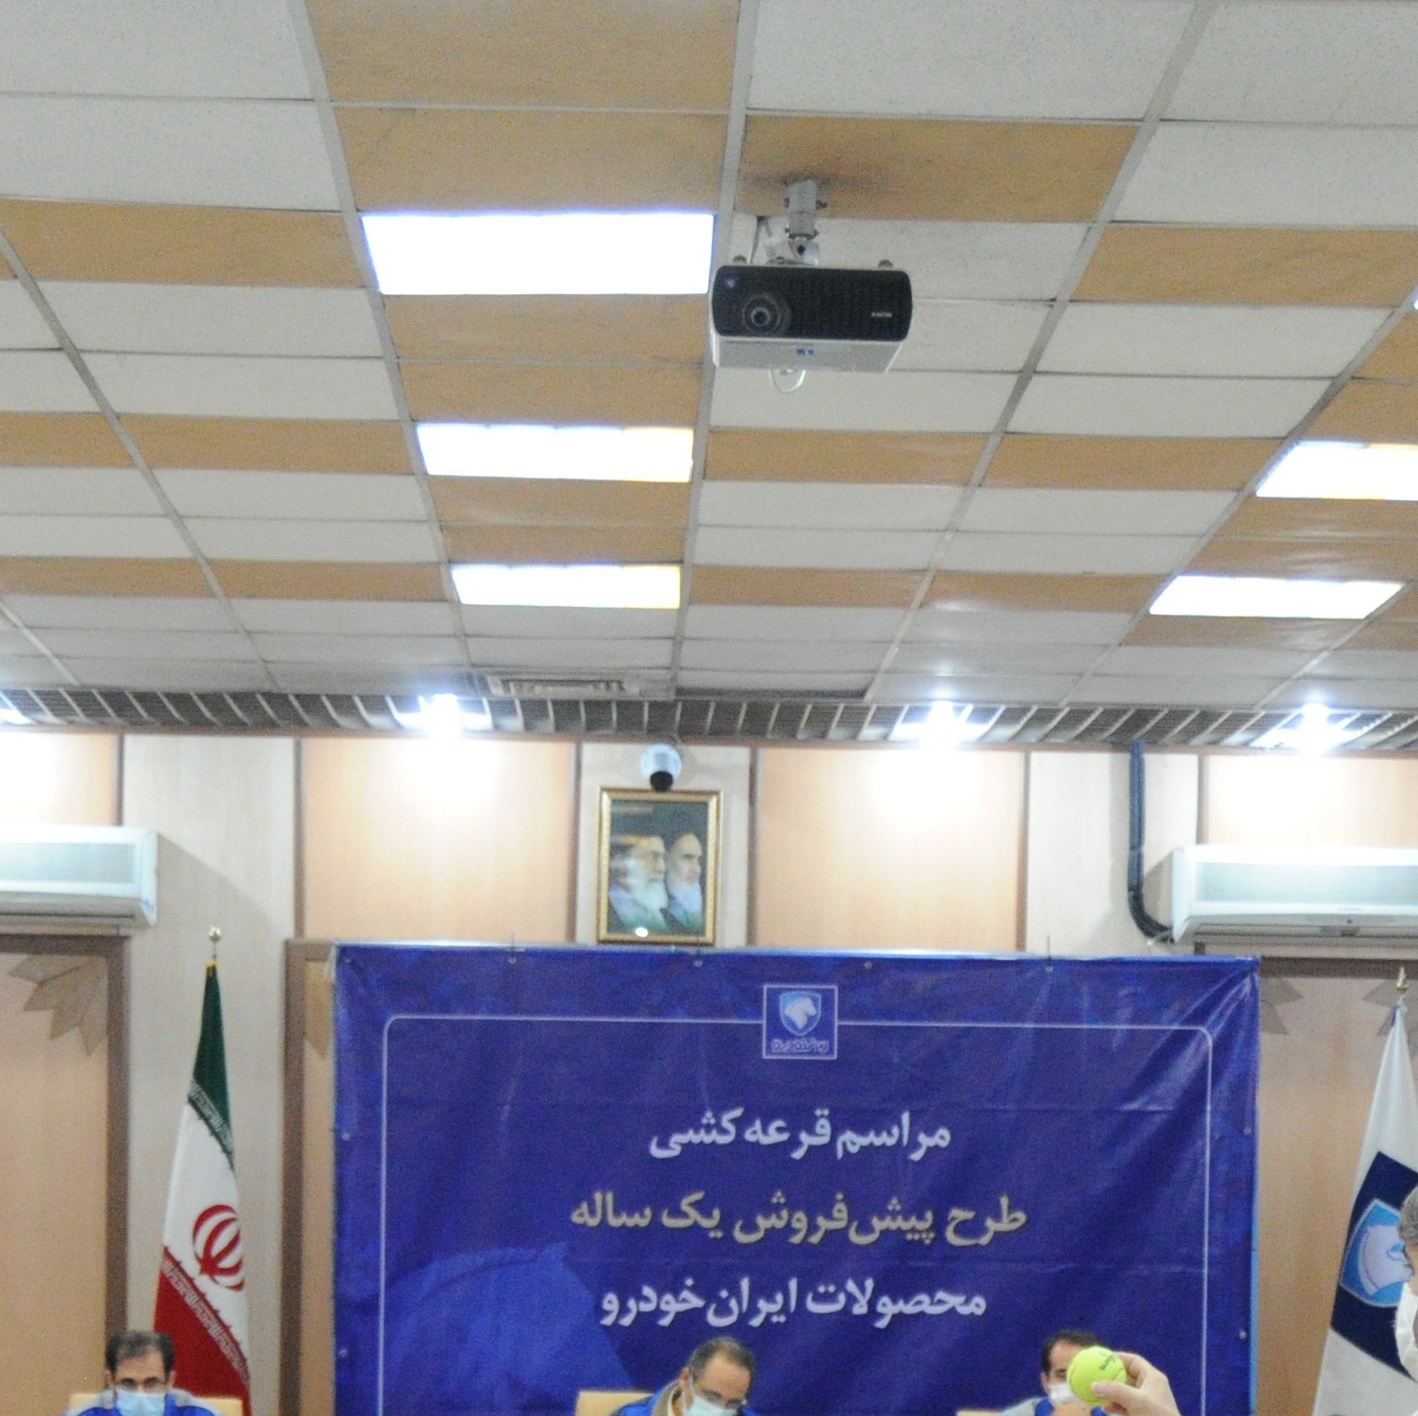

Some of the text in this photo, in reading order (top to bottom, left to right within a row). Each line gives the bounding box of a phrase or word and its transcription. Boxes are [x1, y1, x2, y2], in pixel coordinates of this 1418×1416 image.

[836, 1111, 951, 1161] مراسم
[570, 1190, 653, 1227] ساله
[661, 1191, 722, 1238] یک
[945, 1195, 1027, 1246] طرح
[806, 1277, 987, 1328] محصولات
